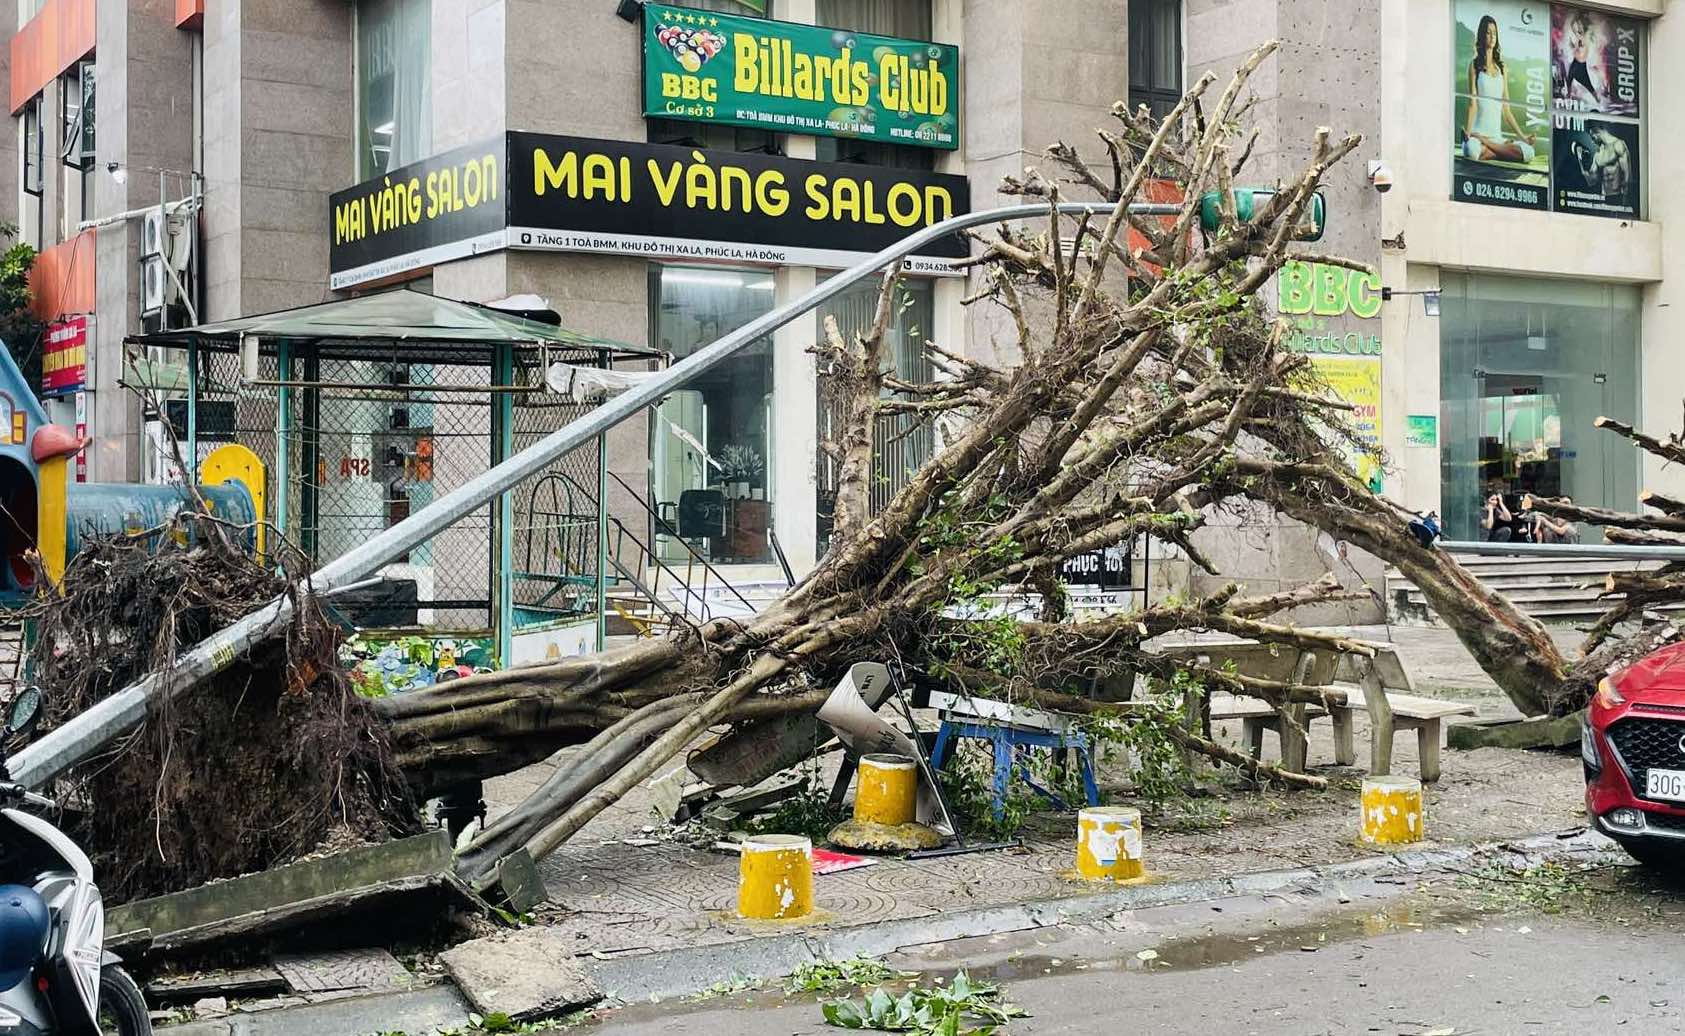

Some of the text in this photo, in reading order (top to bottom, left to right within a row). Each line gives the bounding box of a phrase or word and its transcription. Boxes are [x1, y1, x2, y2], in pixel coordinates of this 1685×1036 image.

[661, 72, 717, 103] BBC
[733, 32, 947, 117] Billards Club
[706, 105, 714, 118] 3
[1526, 66, 1545, 130] YOGA
[806, 117, 814, 128] XA
[335, 154, 497, 245] MAI VÀNG SALON
[533, 147, 953, 227] MAI VÀNG SALON
[565, 237, 570, 246] 1
[573, 235, 592, 248] TOÀ
[621, 241, 641, 251] KHU
[644, 240, 658, 252] ĐÔ
[660, 243, 674, 255] THỊ
[676, 245, 689, 254] XA
[705, 245, 729, 257] PHÚC
[745, 247, 758, 259] HÀ
[759, 249, 785, 261] ĐÔNG
[1278, 260, 1382, 319] BBC
[1344, 331, 1382, 356] Club
[1353, 405, 1376, 417] GYM
